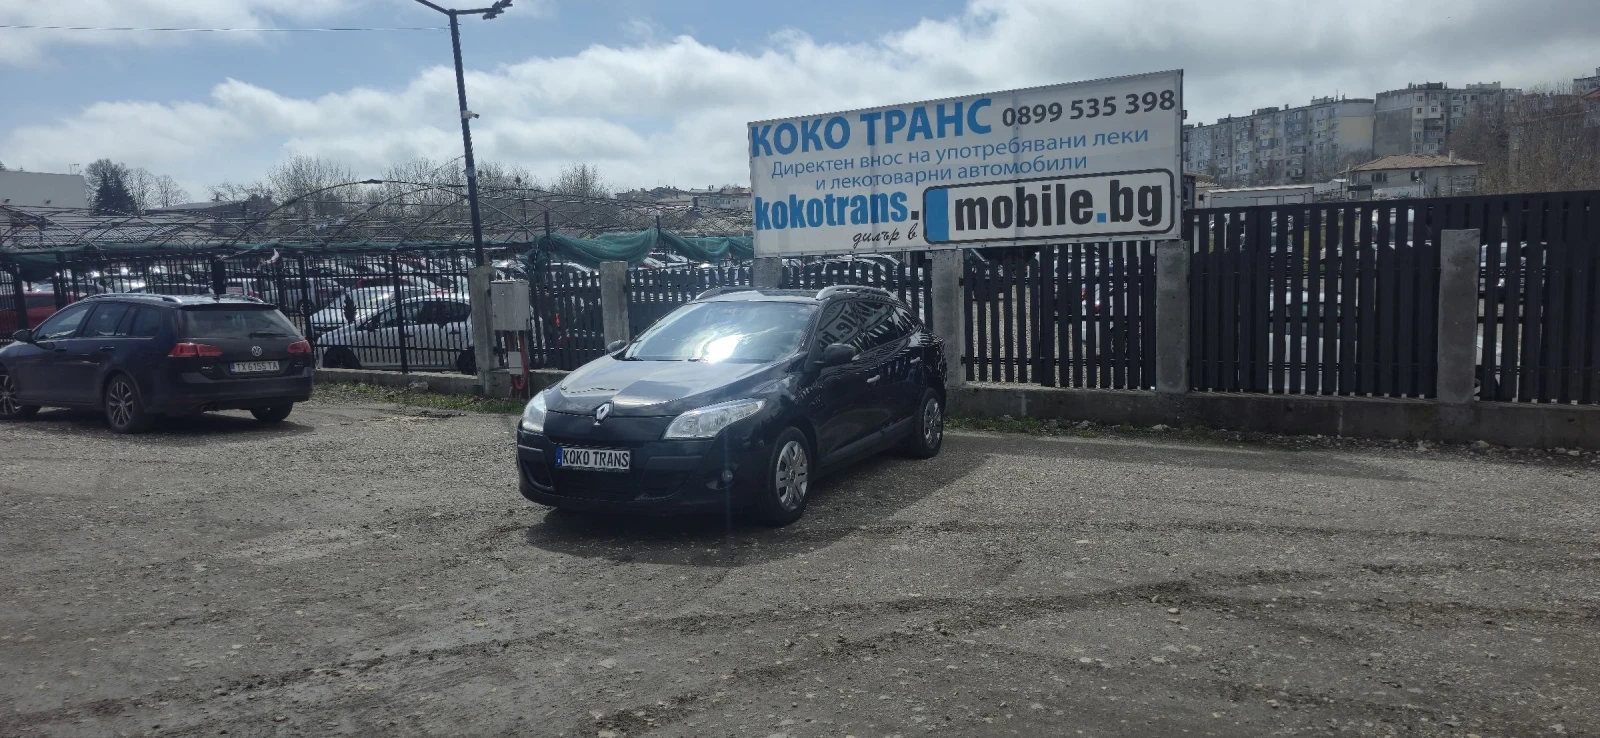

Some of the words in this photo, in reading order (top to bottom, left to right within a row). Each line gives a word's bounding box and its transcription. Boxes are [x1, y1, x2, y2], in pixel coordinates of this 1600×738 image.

[1002, 101, 1063, 127] 0899
[1069, 95, 1117, 120] 535
[1125, 89, 1176, 115] 398
[751, 115, 851, 158] КОКО
[859, 98, 992, 147] ТРАНС
[771, 157, 854, 180] Директен
[860, 152, 904, 167] внос
[908, 149, 931, 164] на
[936, 134, 1086, 165] употребявани
[1092, 129, 1149, 147] леки
[816, 179, 826, 191] и
[830, 168, 951, 190] лекотоварни
[957, 155, 1088, 179] автомобили
[955, 179, 1163, 231] mobile.bg
[853, 227, 901, 250] дилър
[908, 222, 919, 241] в
[248, 362, 267, 371] 6155
[268, 361, 278, 370] TA
[563, 449, 590, 466] KOKO
[593, 451, 629, 468] TRANS
